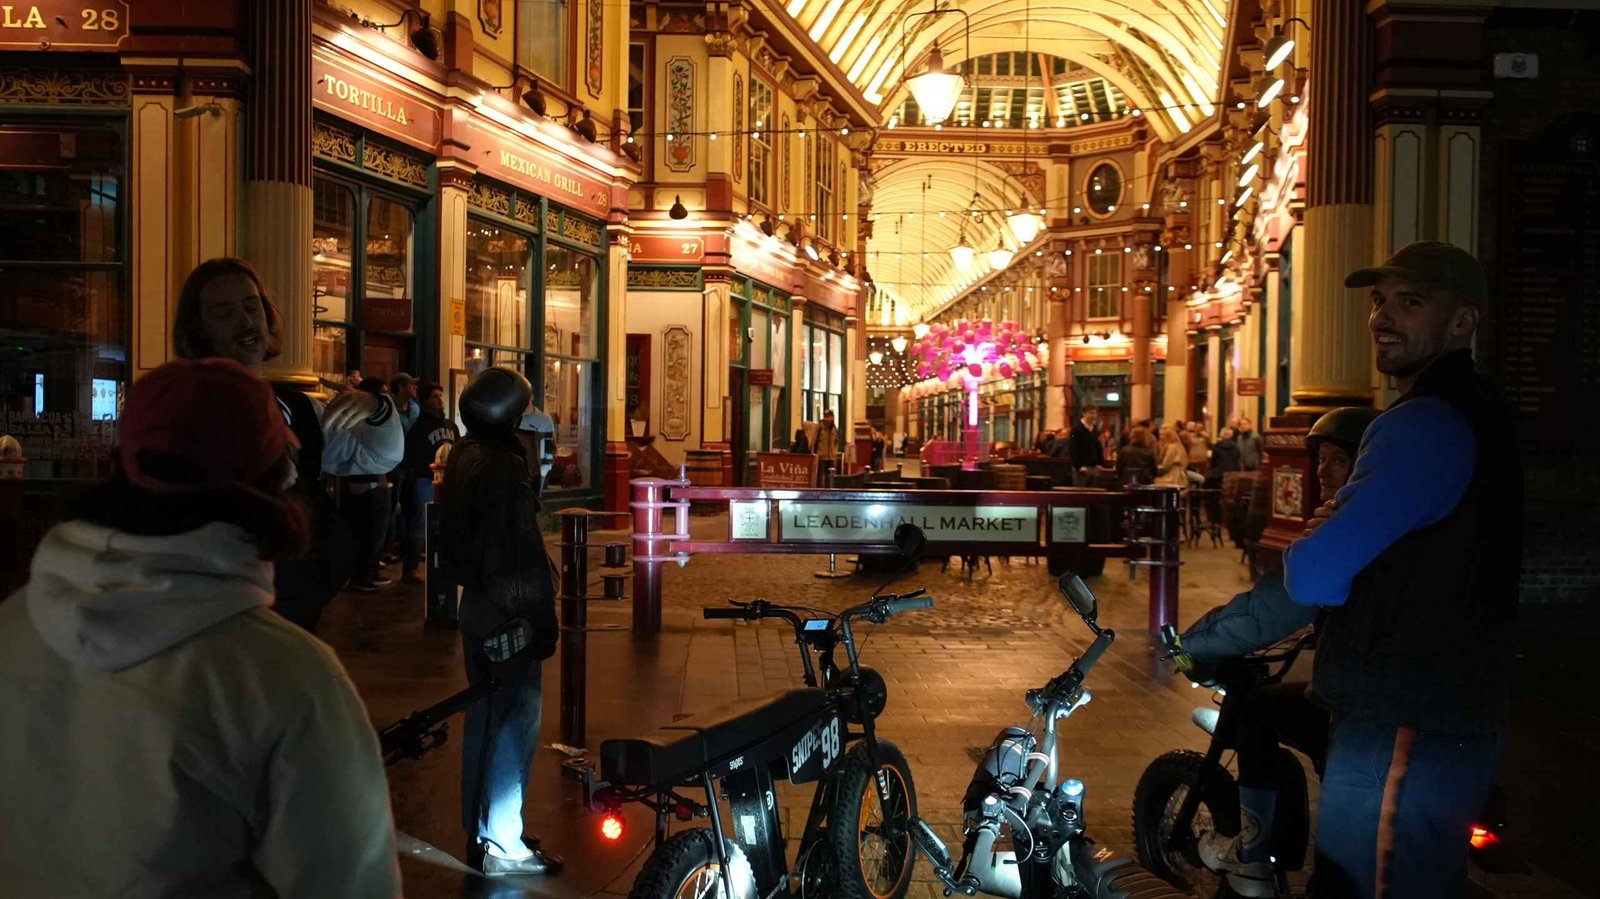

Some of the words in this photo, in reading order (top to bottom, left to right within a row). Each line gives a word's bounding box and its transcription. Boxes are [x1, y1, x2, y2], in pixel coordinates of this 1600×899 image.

[81, 8, 119, 31] 28
[323, 73, 408, 126] TORTILLA
[904, 141, 987, 154] ERECTED
[499, 150, 552, 184] MEXICAN
[554, 173, 584, 198] GRILL
[681, 242, 698, 255] 27
[759, 461, 774, 473] La
[779, 462, 808, 475] Viña
[939, 516, 1027, 532] MARKET
[821, 716, 840, 770] 98
